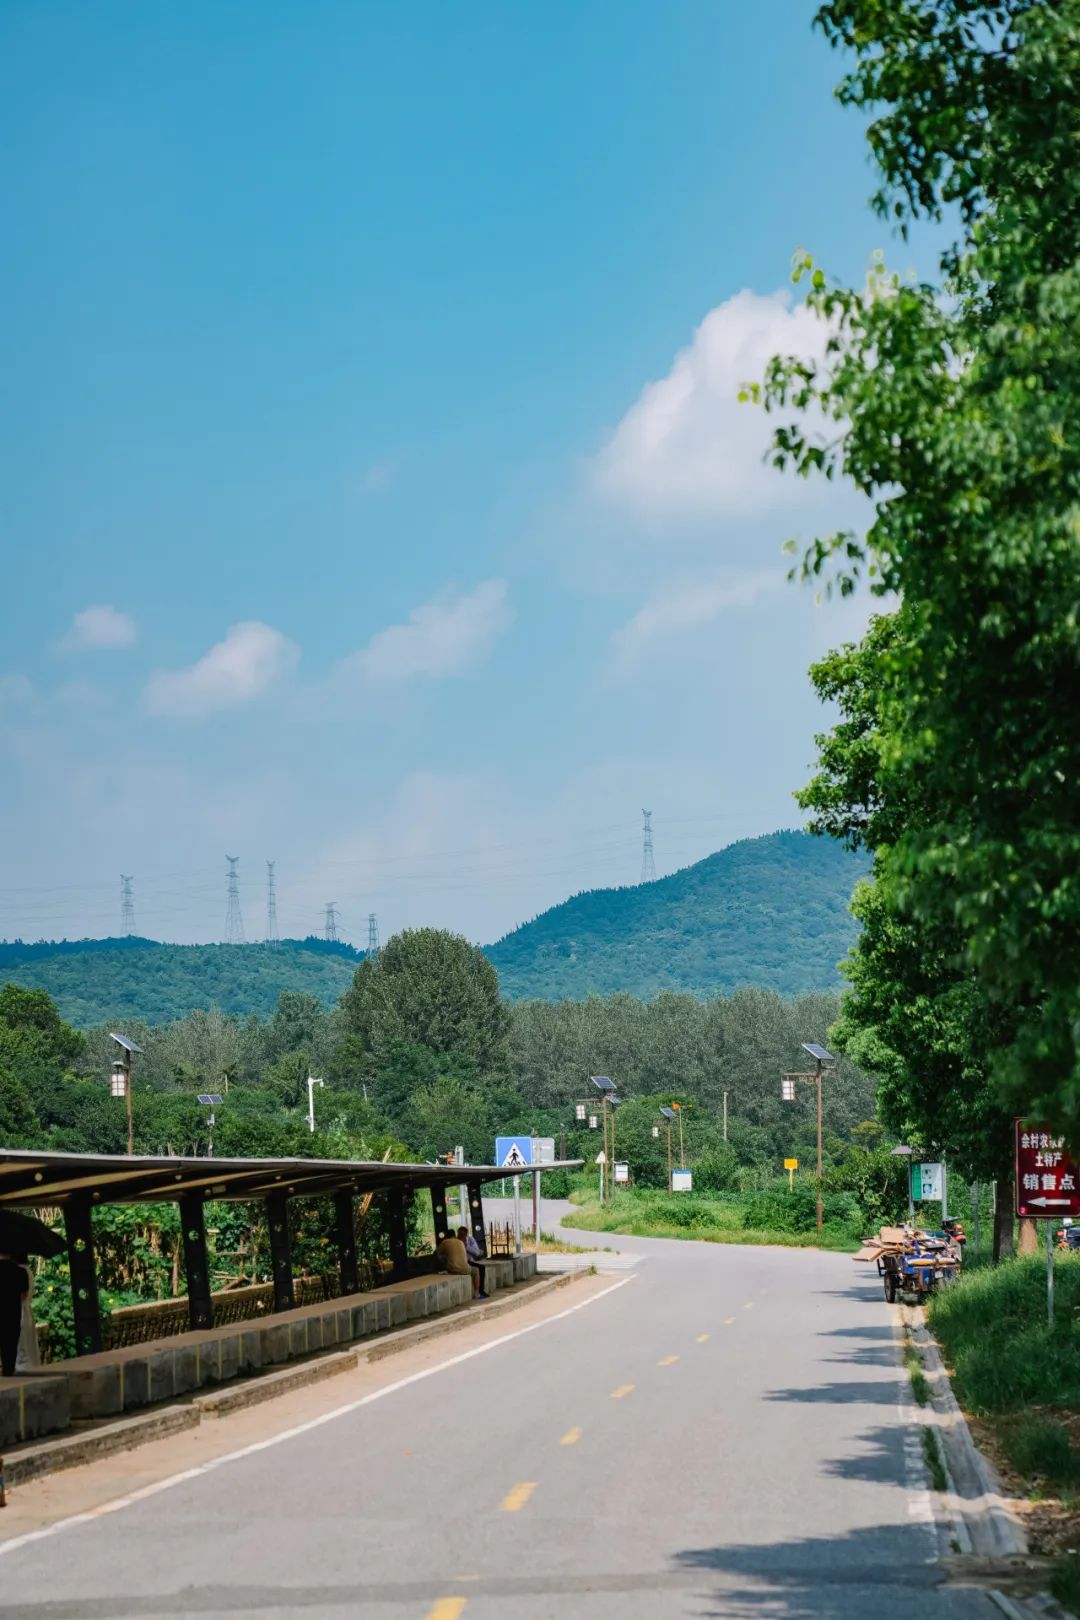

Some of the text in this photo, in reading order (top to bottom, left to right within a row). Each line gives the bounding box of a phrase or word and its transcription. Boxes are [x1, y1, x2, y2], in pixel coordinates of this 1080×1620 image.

[1035, 1151, 1063, 1167] 土特产
[1023, 1173, 1075, 1190] 销售点
